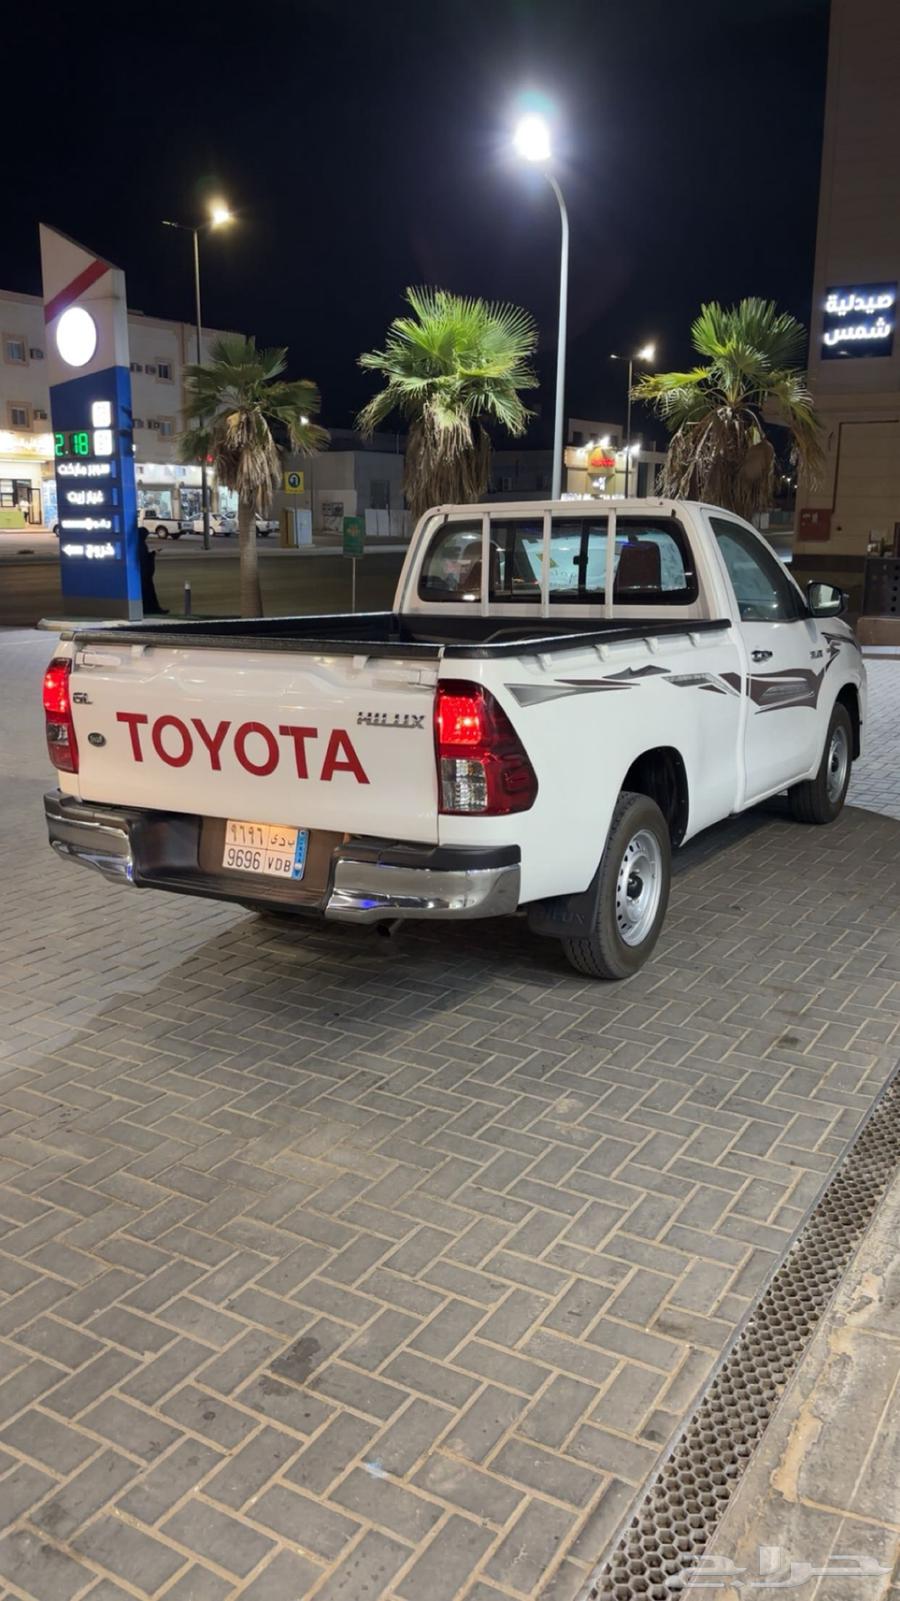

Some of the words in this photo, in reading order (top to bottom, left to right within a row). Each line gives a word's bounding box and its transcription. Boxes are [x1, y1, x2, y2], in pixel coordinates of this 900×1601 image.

[825, 293, 894, 316] صيدلية
[823, 317, 891, 346] شمس
[54, 432, 89, 456] 2.18
[73, 692, 93, 704] GL
[357, 711, 425, 729] HILUX
[116, 712, 370, 784] TOYOTA
[227, 848, 261, 870] 9696
[268, 856, 292, 872] VDB
